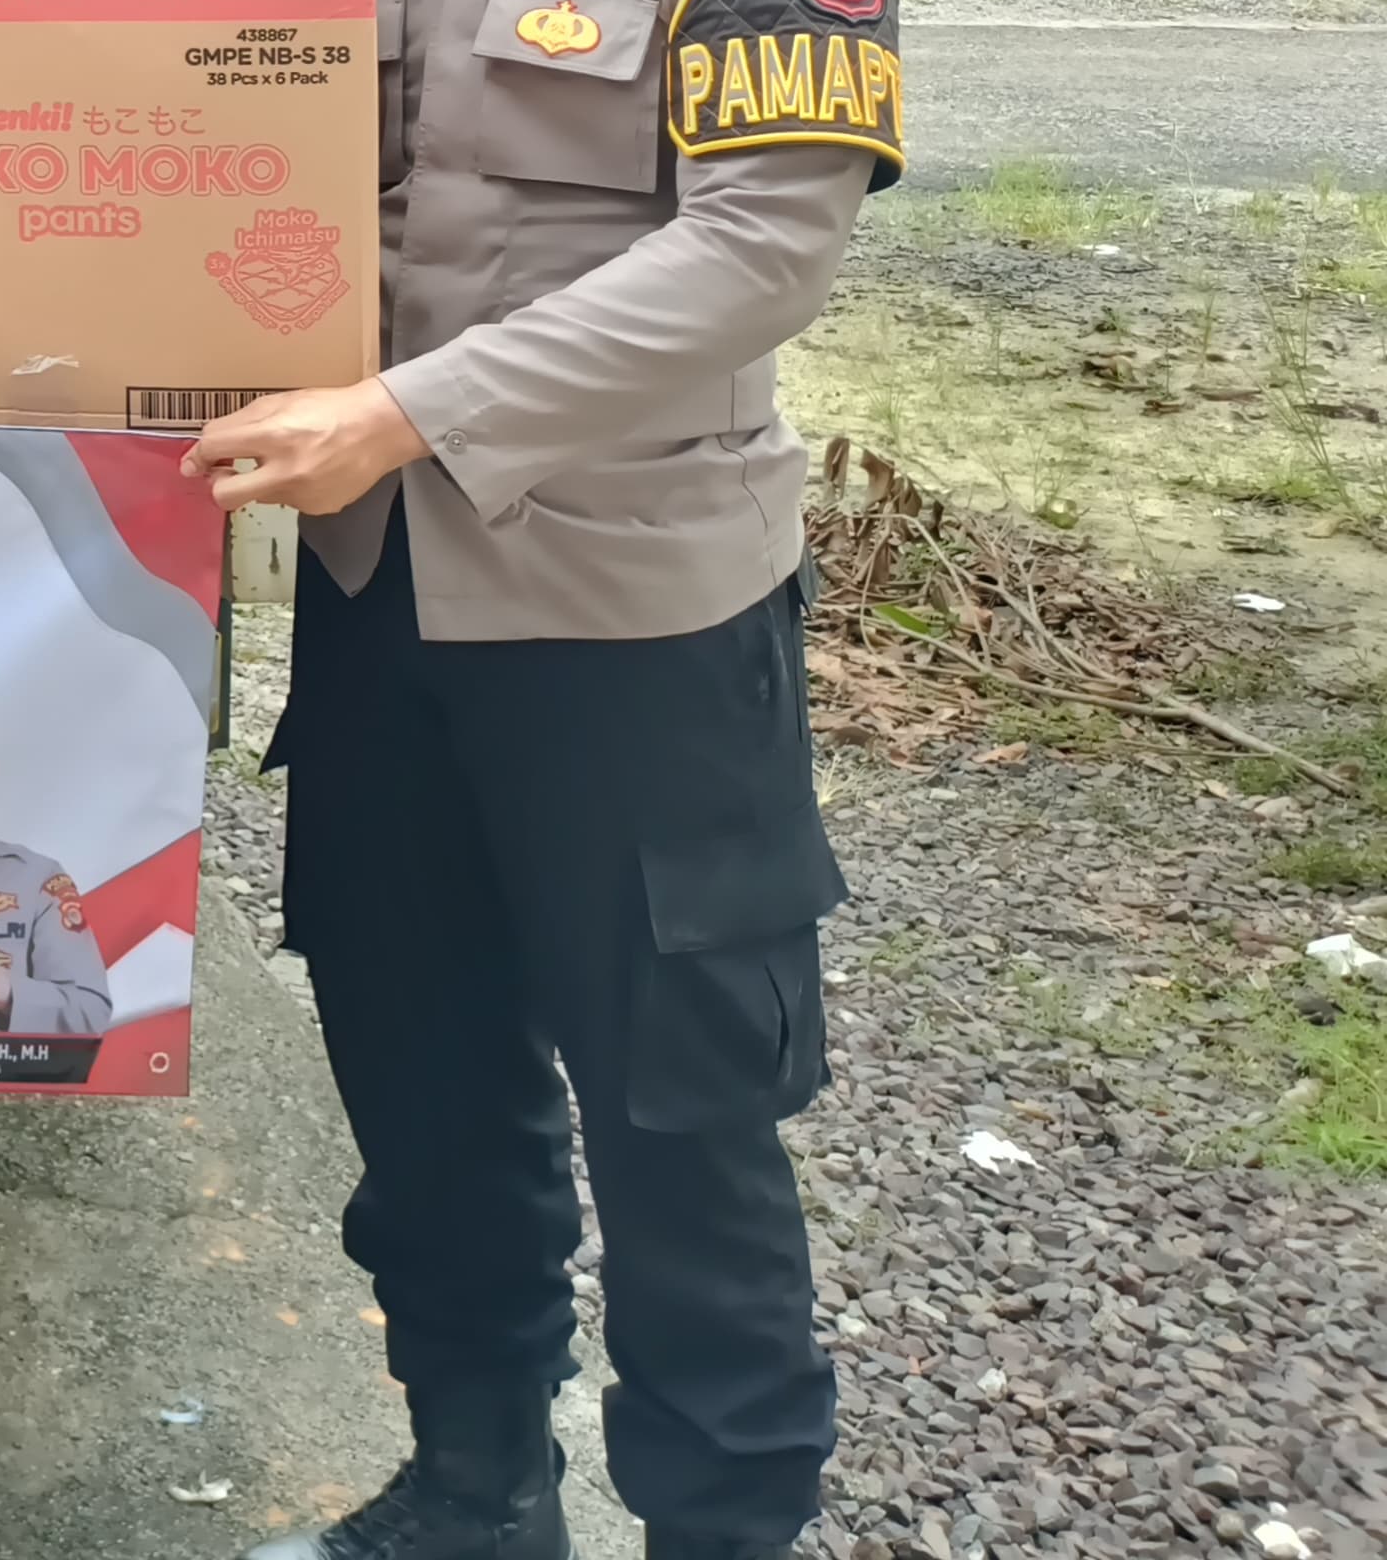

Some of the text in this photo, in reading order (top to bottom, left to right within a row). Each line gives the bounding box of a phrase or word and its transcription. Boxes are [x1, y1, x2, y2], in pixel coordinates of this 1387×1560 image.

[236, 28, 298, 42] 438867
[185, 46, 351, 66] GMPE NB-S 38
[207, 71, 329, 86] 38 Pcs x 6 Pack
[679, 34, 902, 141] PAMAPT
[79, 144, 290, 197] MOKO
[21, 203, 139, 240] pants
[257, 208, 315, 229] Moko
[237, 228, 338, 249] Ichimatsu
[21, 1045, 49, 1061] M.H
